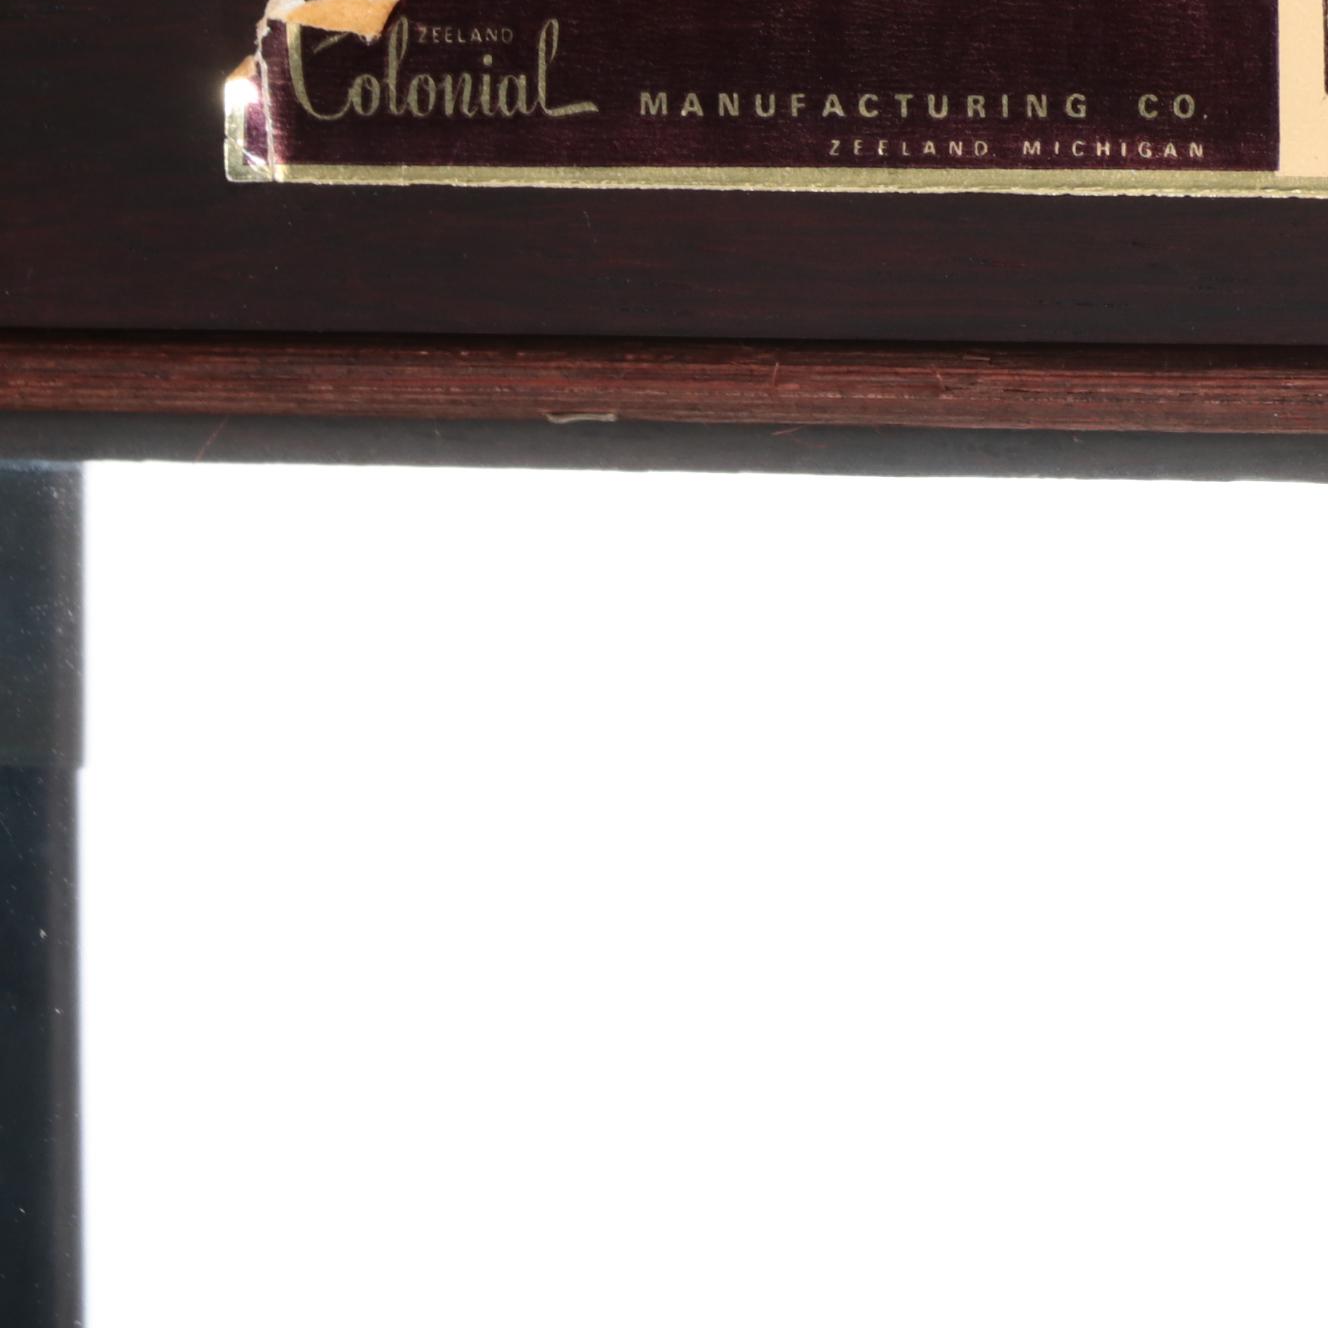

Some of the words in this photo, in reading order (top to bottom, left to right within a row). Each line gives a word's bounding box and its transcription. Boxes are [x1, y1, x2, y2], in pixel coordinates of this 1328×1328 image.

[418, 26, 514, 44] ZEELAND
[640, 92, 1087, 119] MANUFACTURING
[1137, 94, 1208, 120] CO.
[1023, 140, 1206, 158] MICHIGAN
